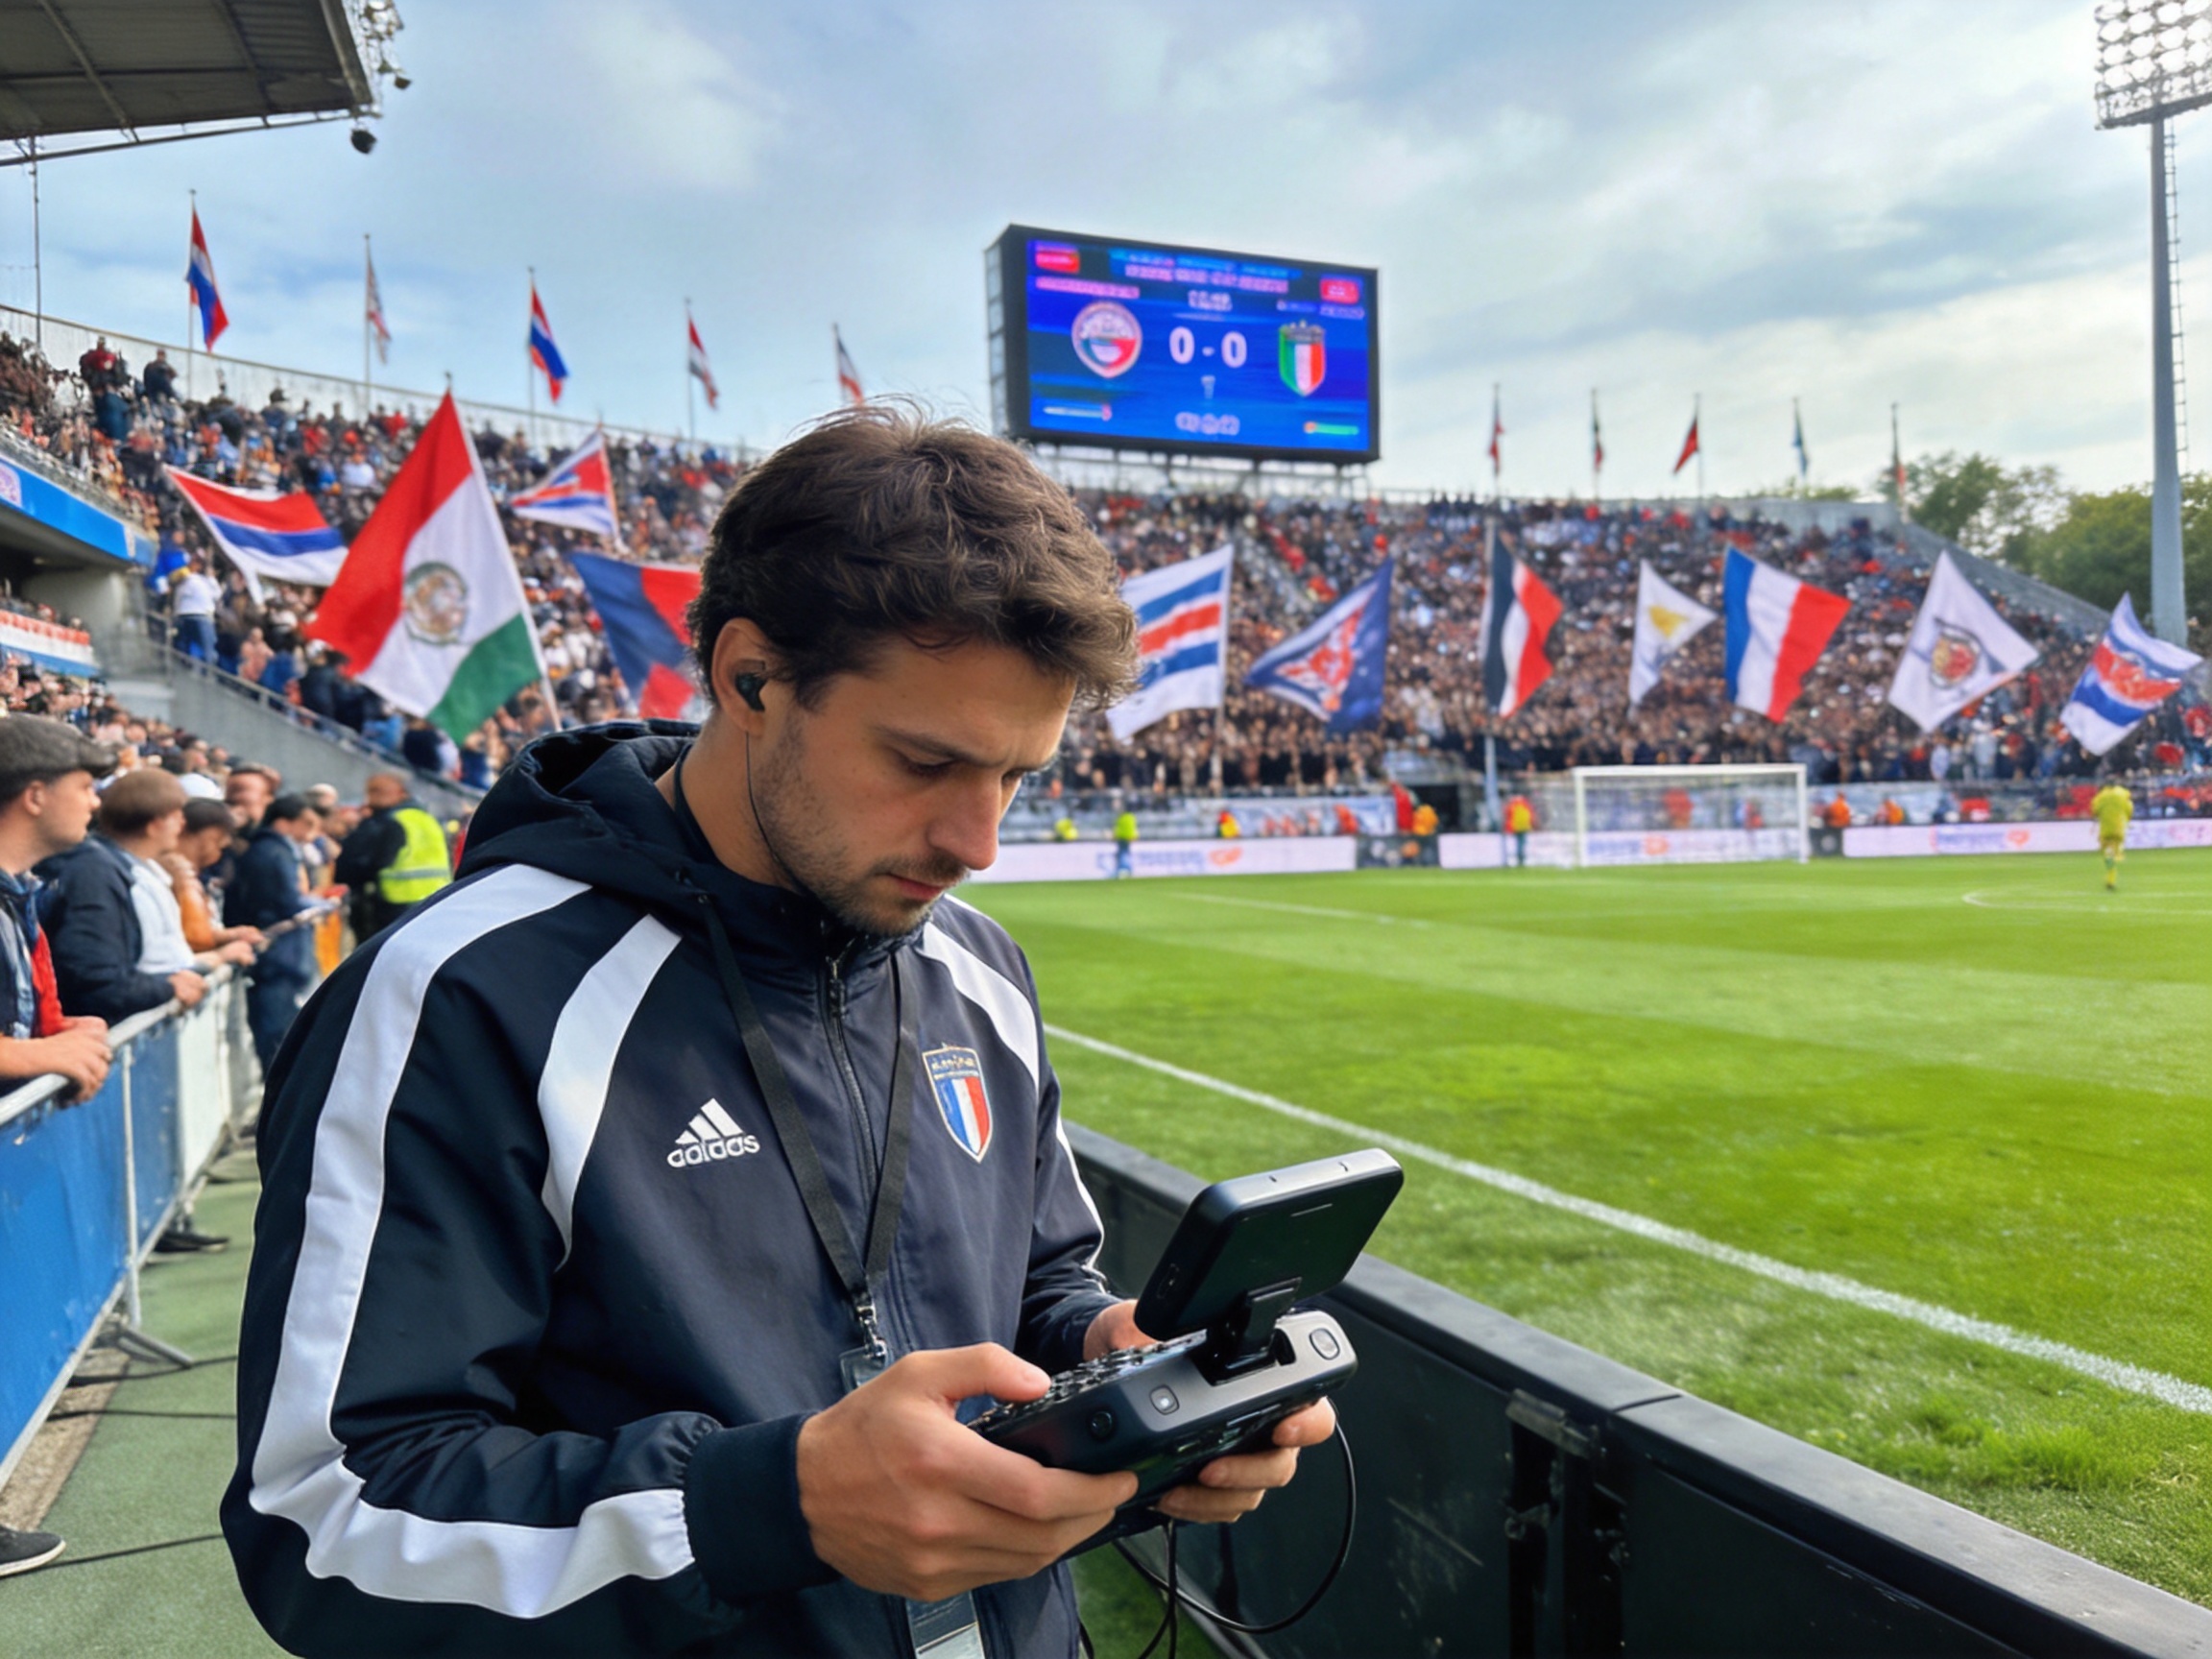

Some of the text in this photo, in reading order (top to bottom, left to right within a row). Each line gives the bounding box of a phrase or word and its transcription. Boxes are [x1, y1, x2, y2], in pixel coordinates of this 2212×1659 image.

[1169, 326, 1195, 364] 0
[1221, 331, 1248, 368] 0
[666, 1134, 760, 1168] adidas
